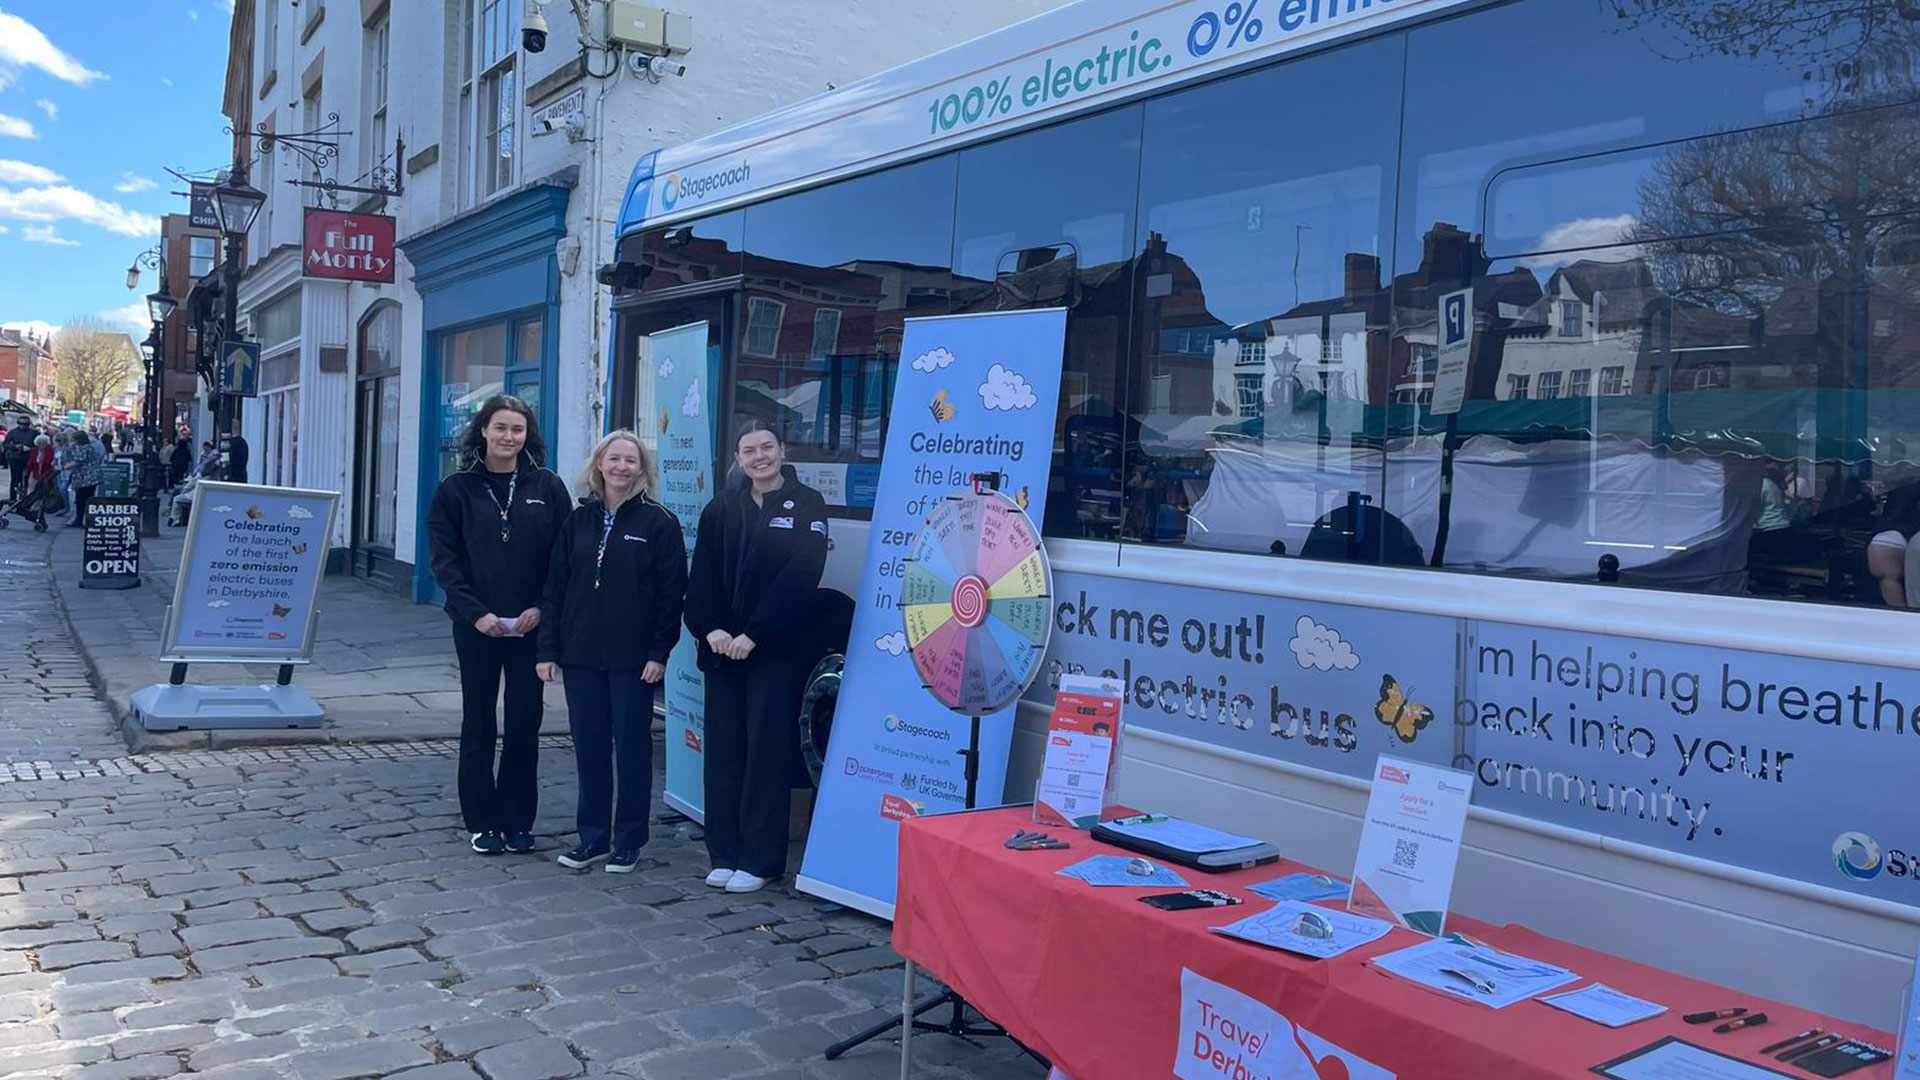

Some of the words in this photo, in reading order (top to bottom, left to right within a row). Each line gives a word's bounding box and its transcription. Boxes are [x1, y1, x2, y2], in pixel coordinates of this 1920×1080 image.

[929, 75, 1011, 134] 100%
[1021, 29, 1172, 108] electric.
[1187, 0, 1263, 58] 0%
[680, 159, 750, 198] Stagecoach
[192, 215, 218, 225] CHIP
[343, 219, 357, 228] The
[325, 231, 374, 251] Full
[307, 249, 390, 274] Monty
[910, 431, 1024, 462] Celebrating
[915, 462, 944, 485] the
[948, 464, 1009, 489] lauh
[88, 504, 139, 515] BARBER
[907, 496, 929, 516] of
[94, 516, 131, 527] SHOP
[224, 519, 301, 536] Celebrating
[228, 533, 248, 544] the
[251, 534, 292, 546] launch
[881, 529, 917, 546] zer
[225, 547, 240, 556] of
[242, 548, 262, 558] the
[265, 549, 288, 559] first
[85, 560, 137, 574] OPEN
[210, 561, 239, 570] zero
[242, 562, 298, 573] emission
[209, 572, 256, 584] electric
[259, 575, 294, 586] buses
[207, 585, 217, 595] in
[221, 586, 290, 599] Derbyshire.
[876, 587, 892, 609] in
[1109, 606, 1170, 647] me
[1181, 614, 1266, 664] out!
[1531, 639, 1700, 715] helping
[1269, 685, 1357, 752] bus
[898, 720, 950, 741] Stagecoach
[1454, 686, 1554, 742] back
[1568, 703, 1656, 760] into
[1673, 733, 1794, 784] your
[919, 785, 931, 796] UK
[921, 774, 948, 789] Funded
[948, 781, 958, 793] by
[1197, 999, 1269, 1058] Travel
[1194, 1031, 1271, 1080] Derb
